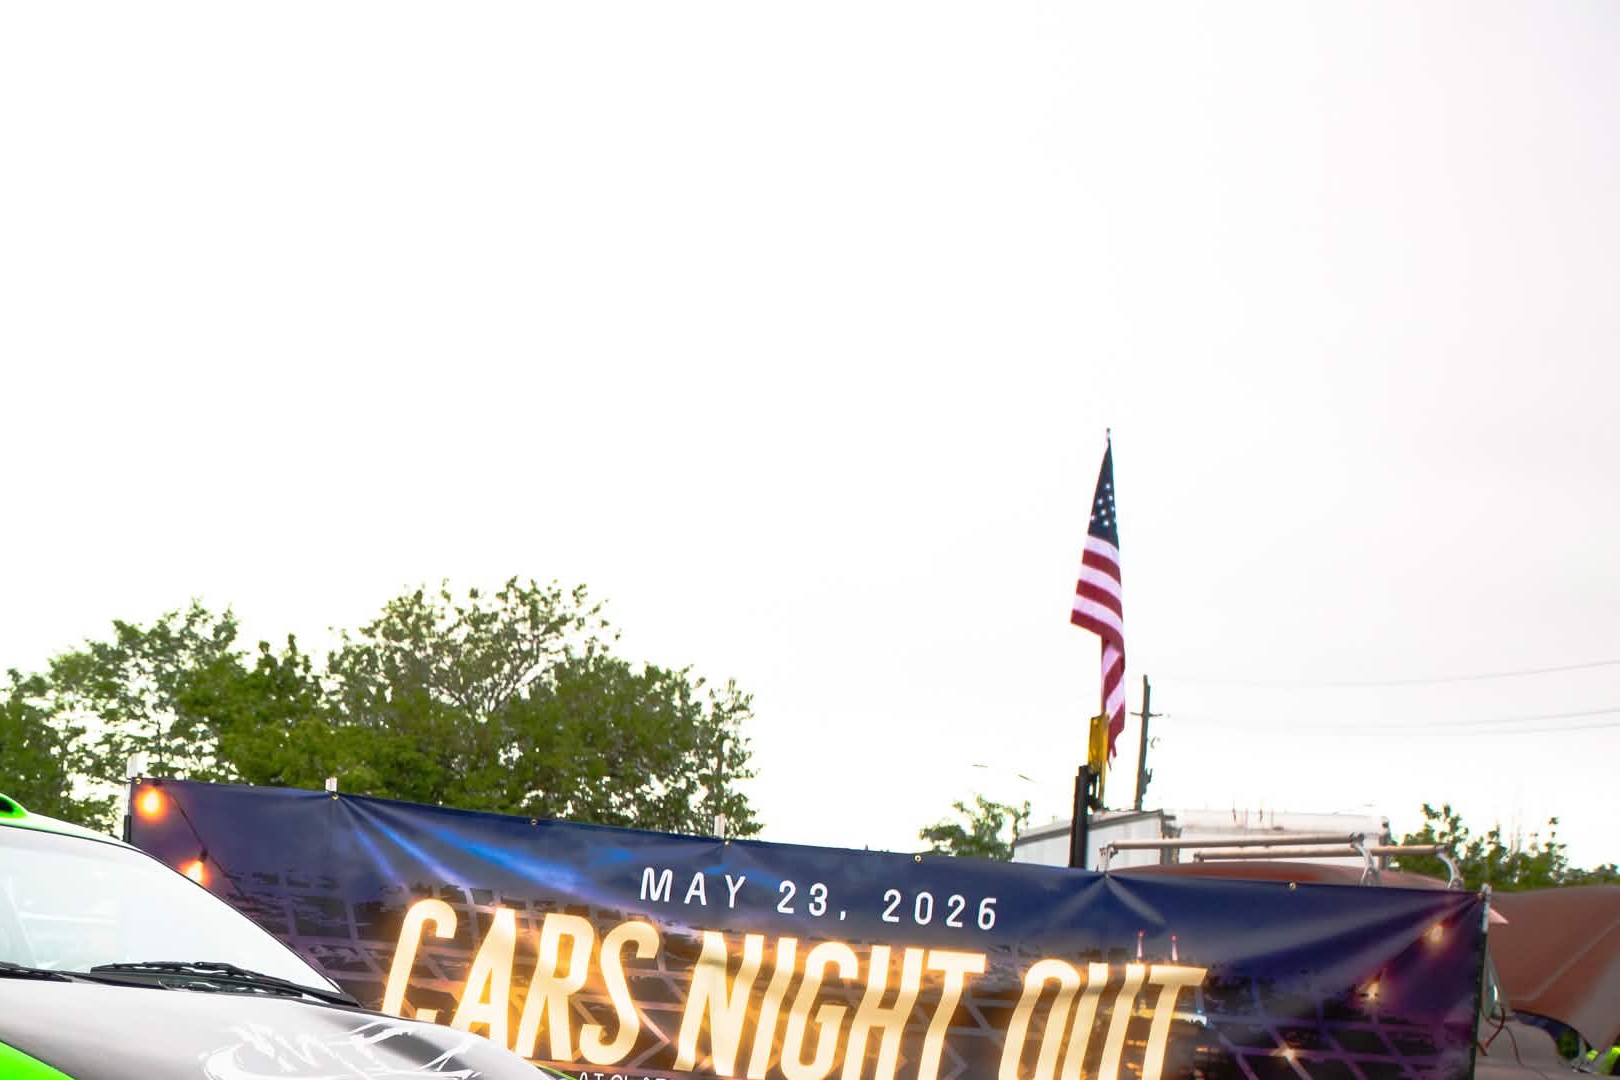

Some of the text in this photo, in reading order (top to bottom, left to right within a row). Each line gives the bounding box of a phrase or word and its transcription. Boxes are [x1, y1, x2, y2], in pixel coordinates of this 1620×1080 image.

[640, 867, 997, 930] MAY 23, 2026
[382, 898, 660, 1066] CARS
